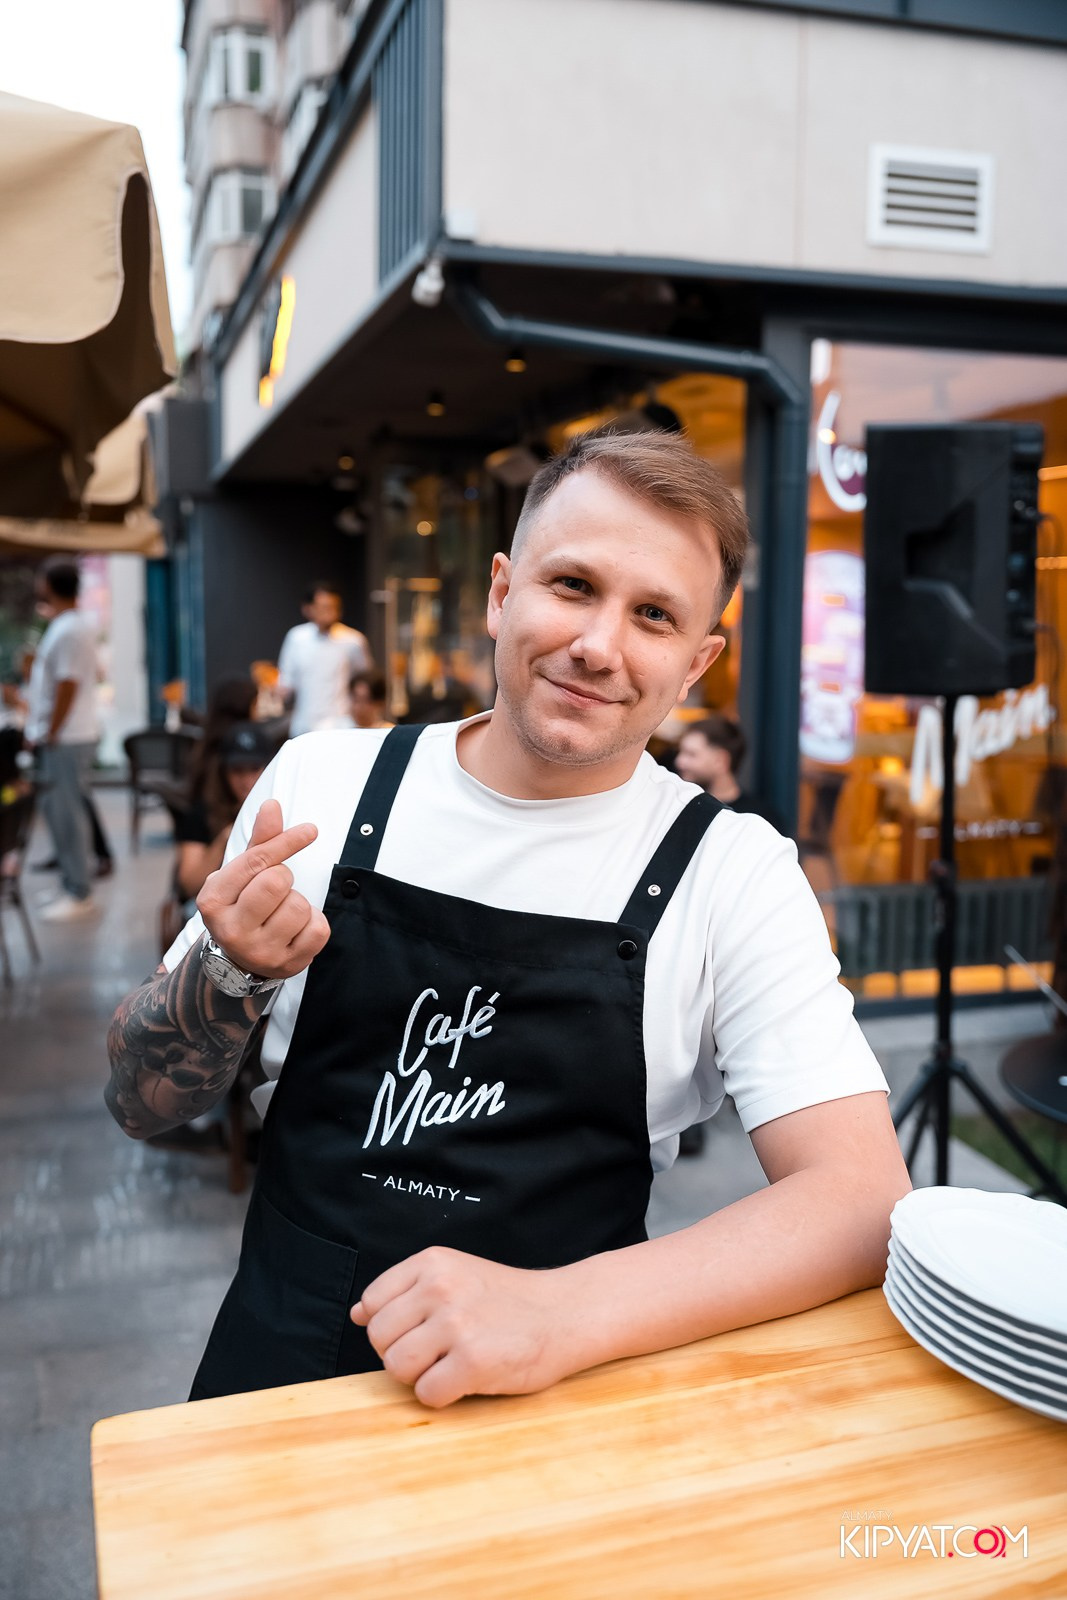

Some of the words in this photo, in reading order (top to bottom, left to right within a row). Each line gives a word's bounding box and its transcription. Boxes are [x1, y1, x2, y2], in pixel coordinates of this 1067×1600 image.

[398, 985, 501, 1077] Café
[361, 1069, 505, 1149] Main
[383, 1175, 461, 1201] ALMATY
